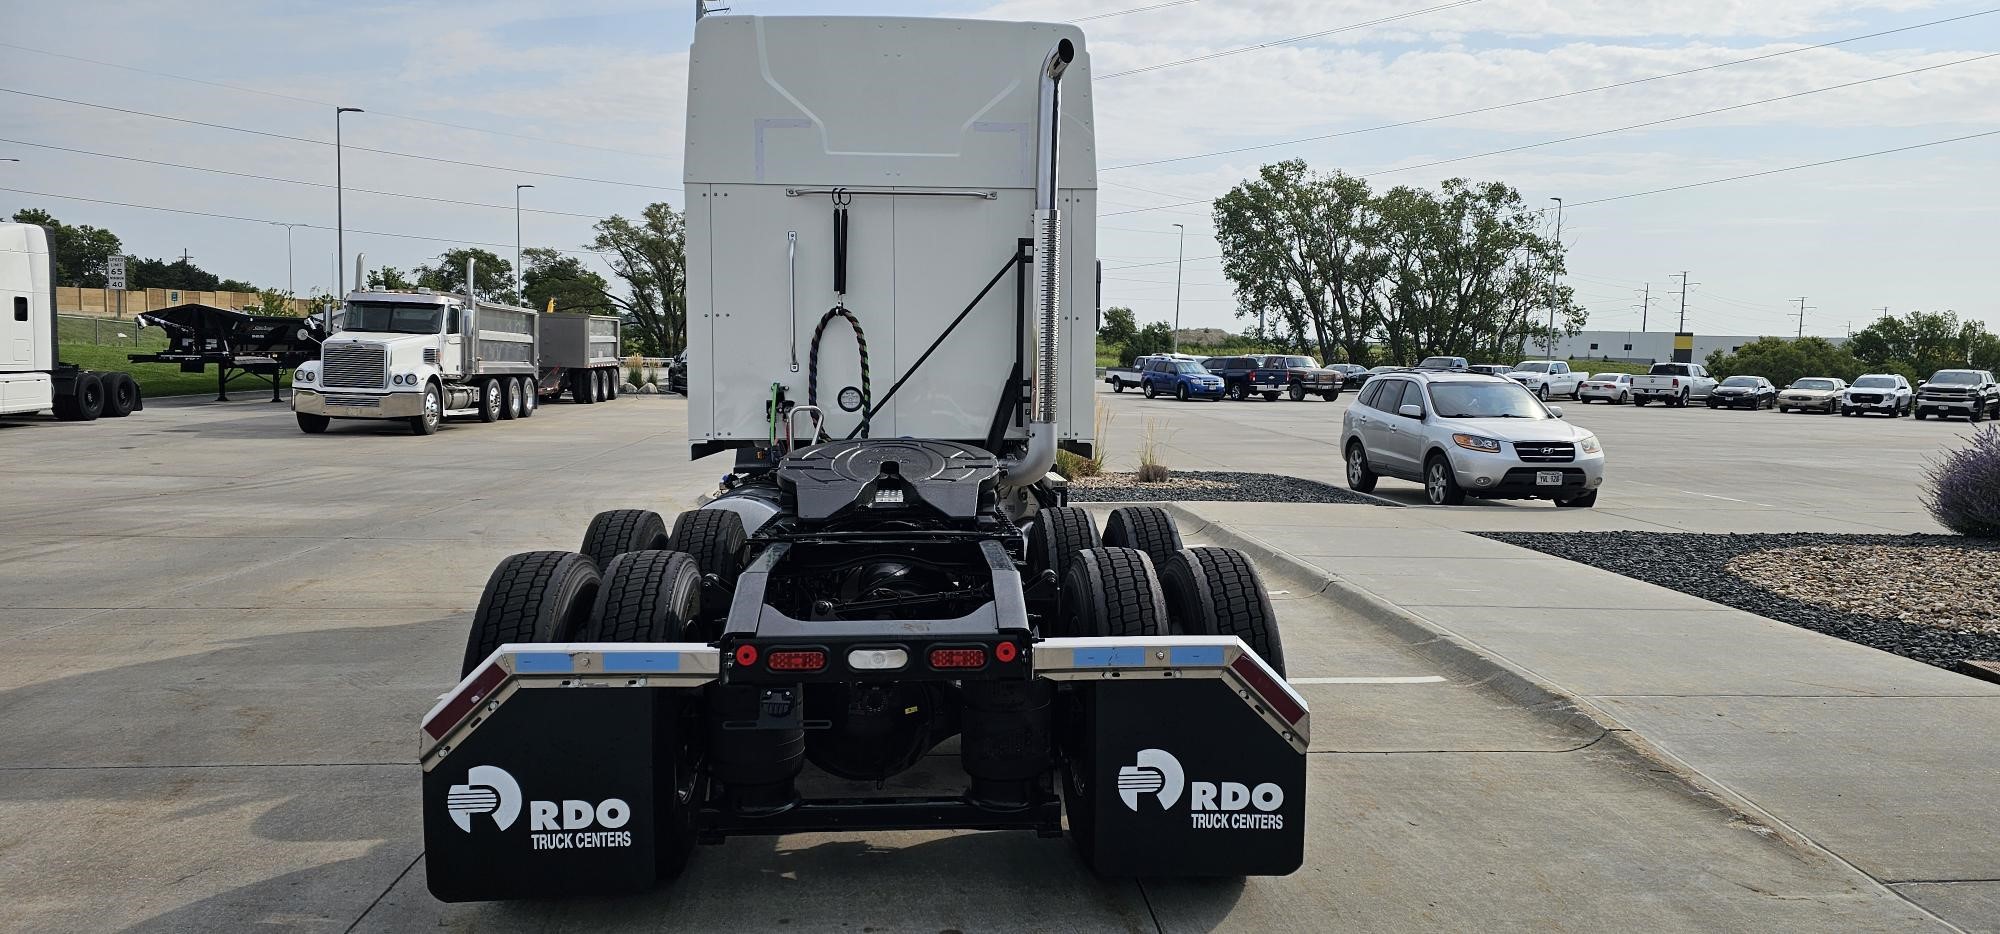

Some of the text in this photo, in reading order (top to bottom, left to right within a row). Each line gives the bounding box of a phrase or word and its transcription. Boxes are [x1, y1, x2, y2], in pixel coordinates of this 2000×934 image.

[1191, 781, 1284, 812] RDO
[530, 798, 631, 831] RDO
[1191, 813, 1284, 830] TRUCK CENTERS
[530, 830, 632, 850] TRUCK CENTERS
